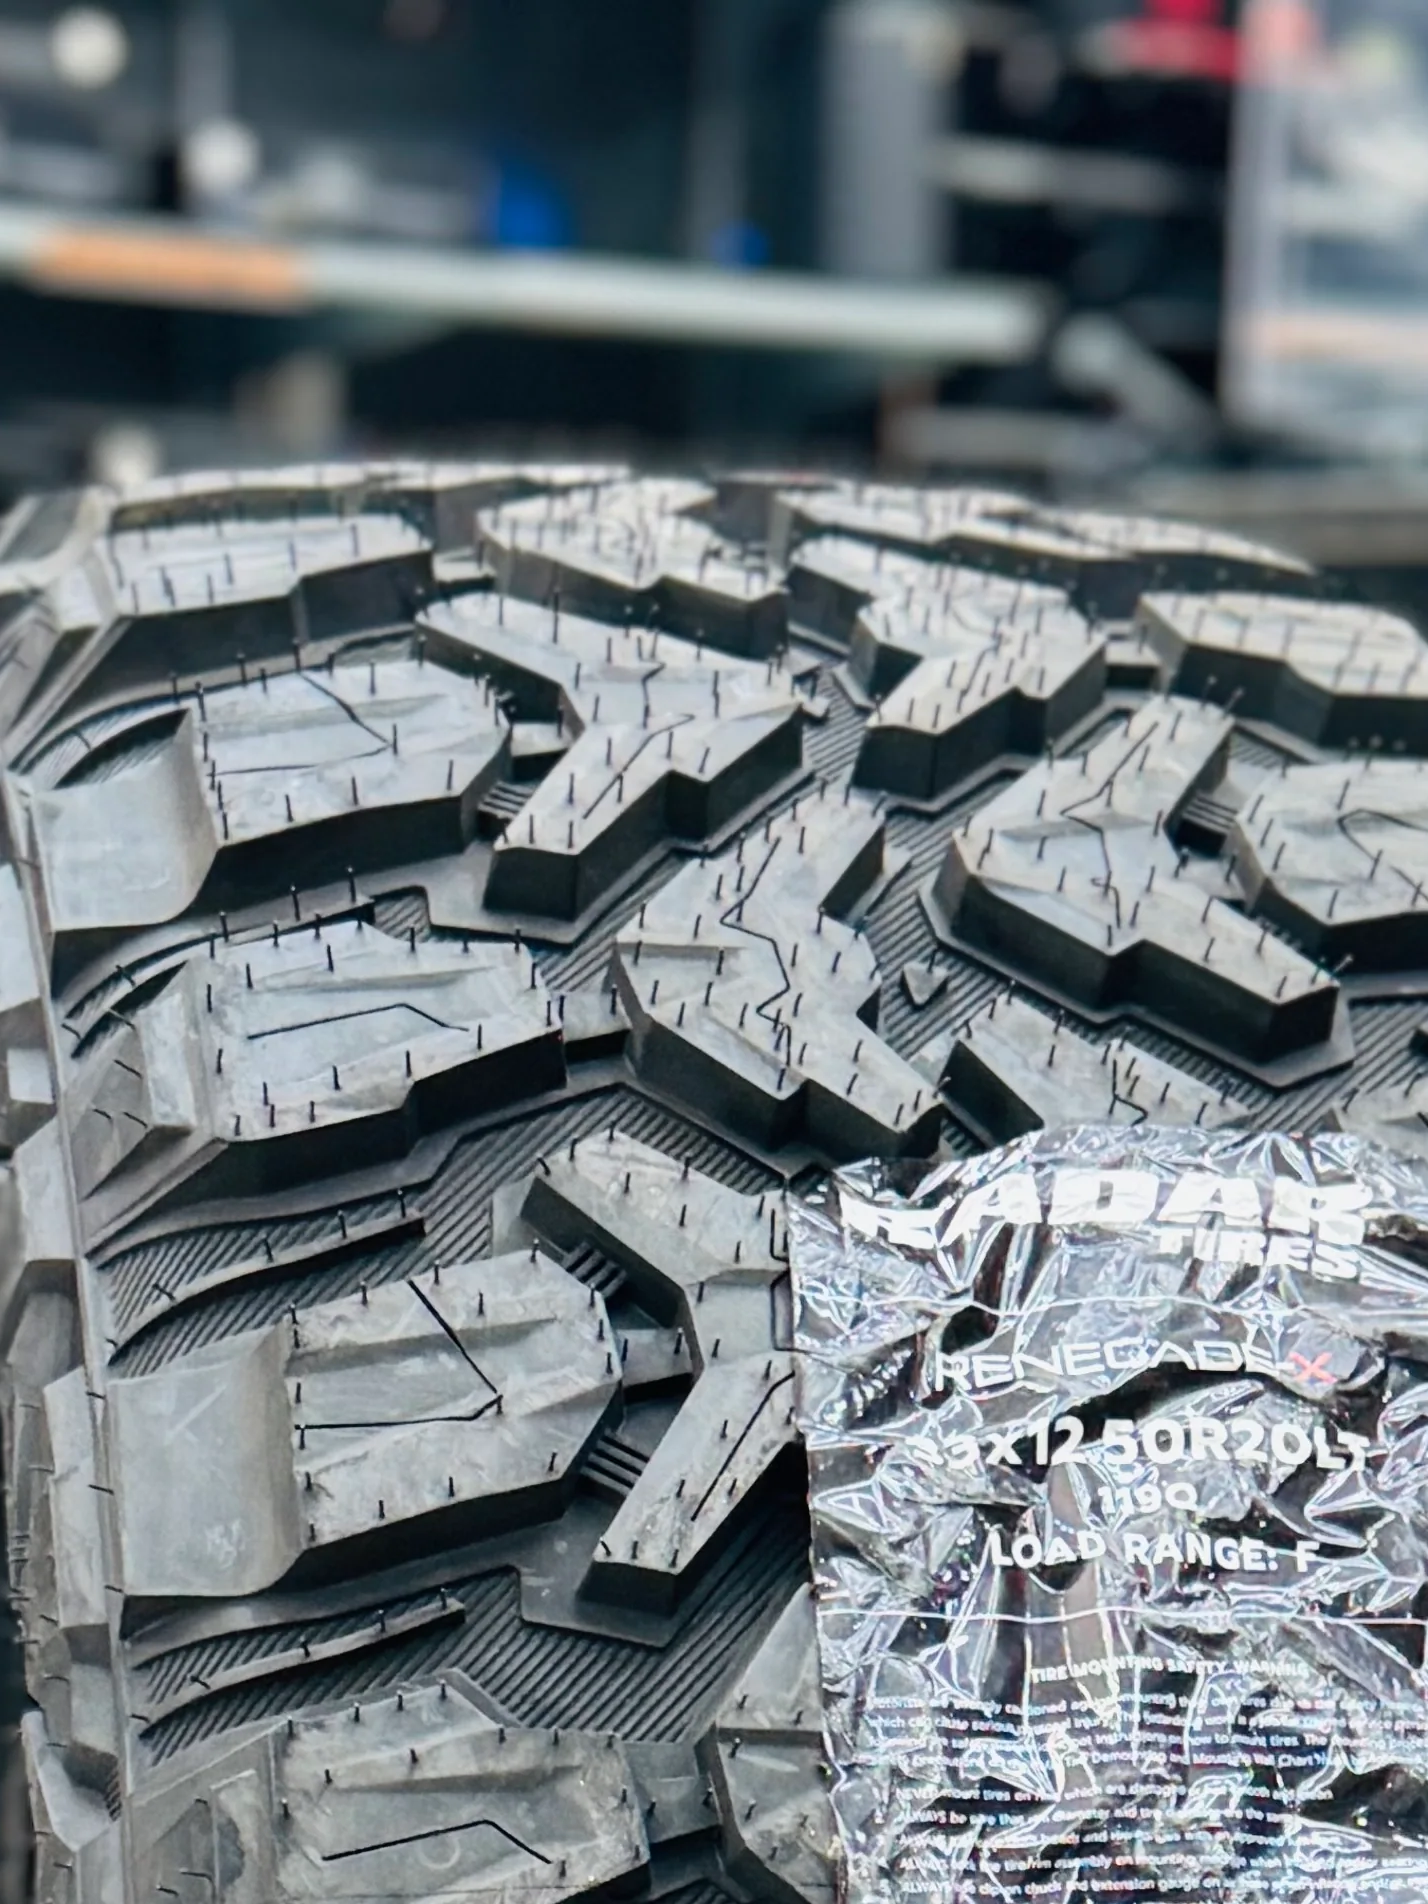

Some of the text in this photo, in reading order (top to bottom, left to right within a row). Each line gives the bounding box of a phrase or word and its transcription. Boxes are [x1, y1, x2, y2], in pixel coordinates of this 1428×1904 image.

[1154, 1227, 1359, 1282] TIRES
[1098, 1481, 1199, 1515] 119Q
[991, 1530, 1320, 1573] LOAD RANGE: F
[1031, 1665, 1068, 1684] TIRE
[1073, 1656, 1164, 1678] MOUNTING
[1166, 1658, 1227, 1675] SAFETY
